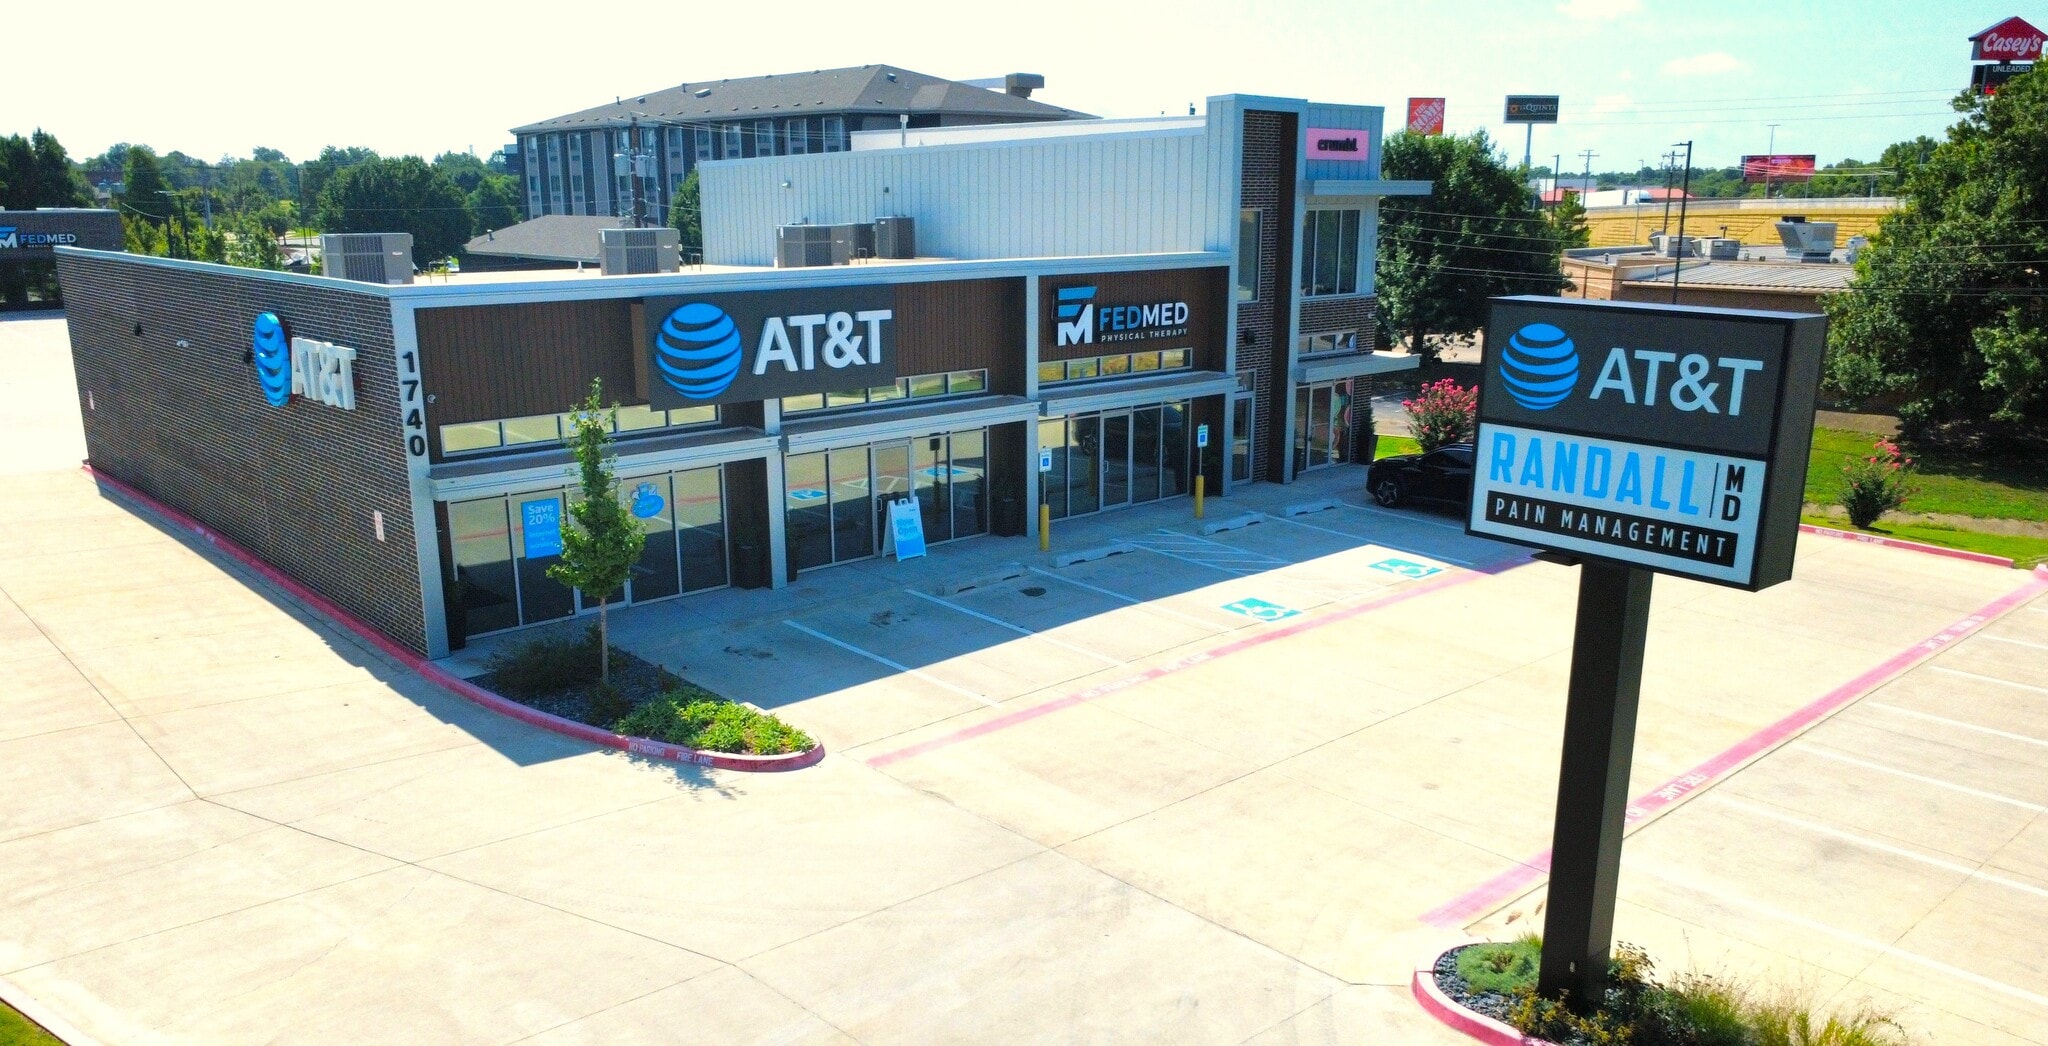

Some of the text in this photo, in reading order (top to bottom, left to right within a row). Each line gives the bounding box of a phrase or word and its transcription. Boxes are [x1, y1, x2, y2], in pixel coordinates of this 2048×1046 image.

[1983, 33, 2042, 56] Casey's
[1992, 65, 2031, 73] UNLEADED
[1408, 98, 1444, 131] HOME
[1414, 102, 1428, 116] THE
[1422, 111, 1443, 135] DEPOT
[20, 233, 77, 244] FEDMED
[1099, 301, 1190, 332] FEDMED
[751, 308, 893, 376] AT&T
[1101, 327, 1188, 343] PHYSICAL THERAPY
[291, 336, 357, 411] AT&T
[1588, 347, 1764, 417] AT&T
[401, 350, 427, 457] 1740
[1489, 431, 1701, 516] RANDALL
[528, 504, 554, 515] Save
[528, 512, 556, 526] 20%
[897, 526, 918, 537] Open
[1494, 497, 1728, 558] PAIN MANAGEMENT
[628, 741, 714, 767] NO PARKING FIRE LANE
